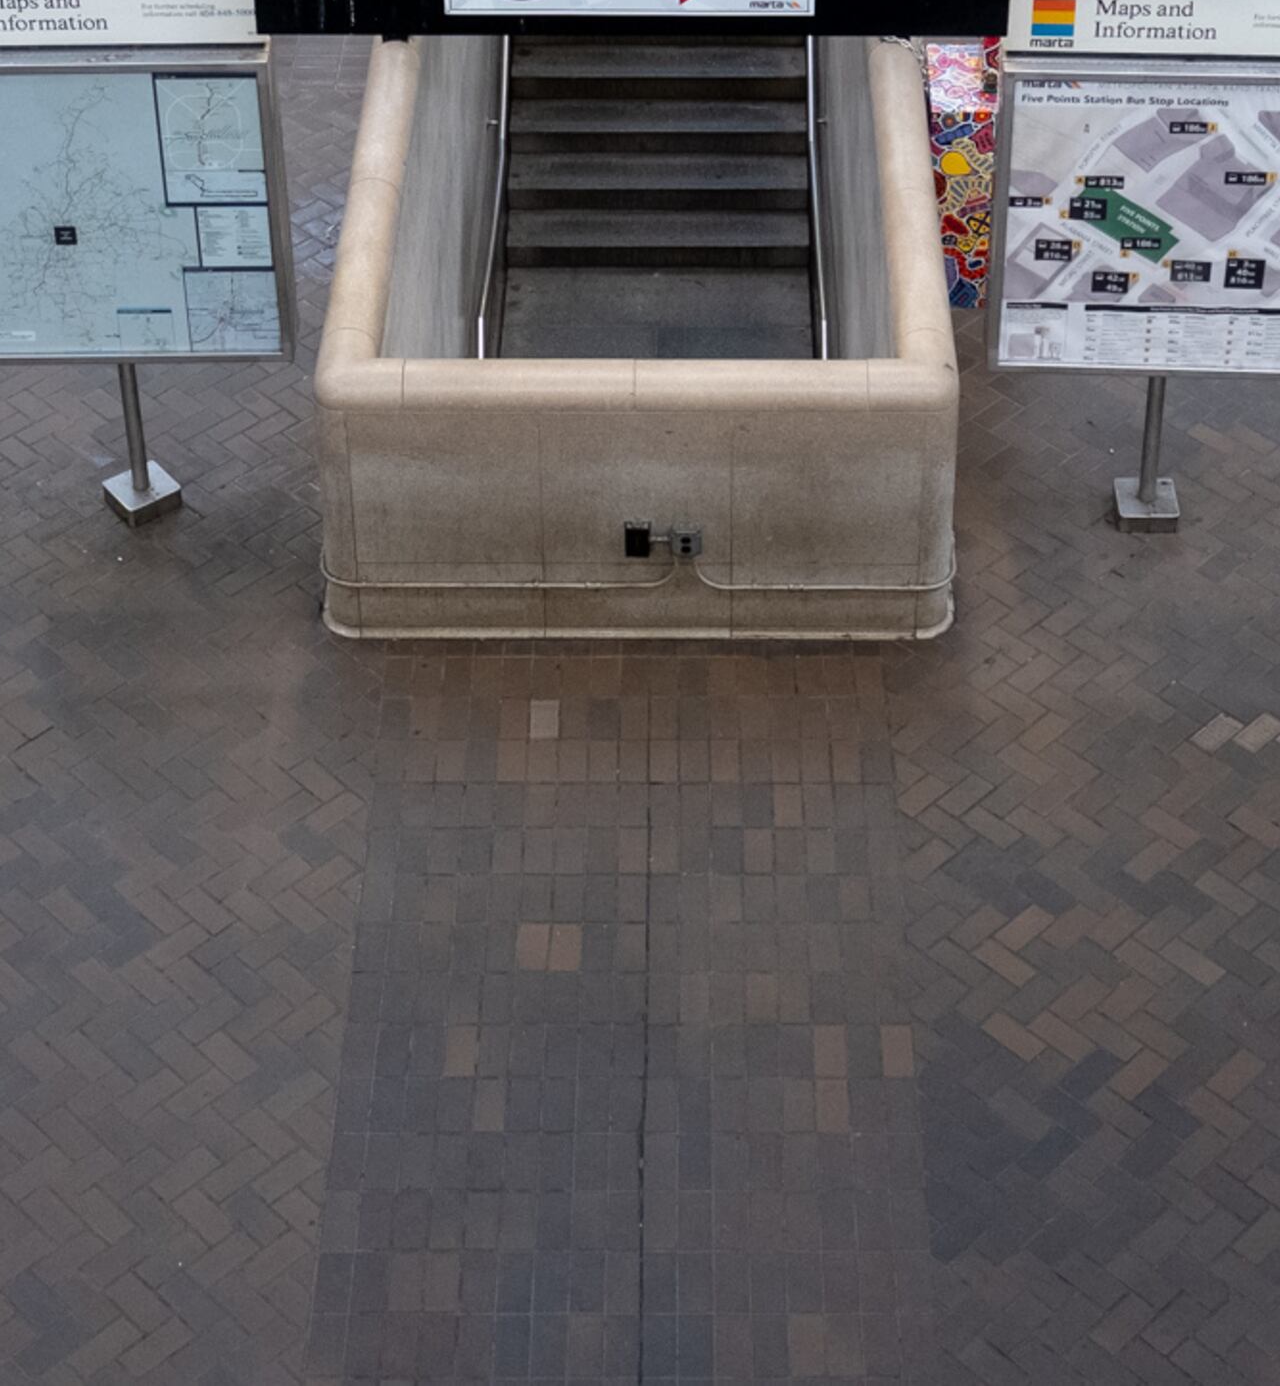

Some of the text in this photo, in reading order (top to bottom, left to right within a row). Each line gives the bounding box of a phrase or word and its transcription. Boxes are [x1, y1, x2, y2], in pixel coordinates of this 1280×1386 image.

[749, 0, 784, 9] marta
[1095, 0, 1195, 20] Maps and
[1094, 22, 1217, 40] Information
[1029, 38, 1075, 49] marta
[1021, 94, 1229, 107] Five Points Station Bus Stop Locations
